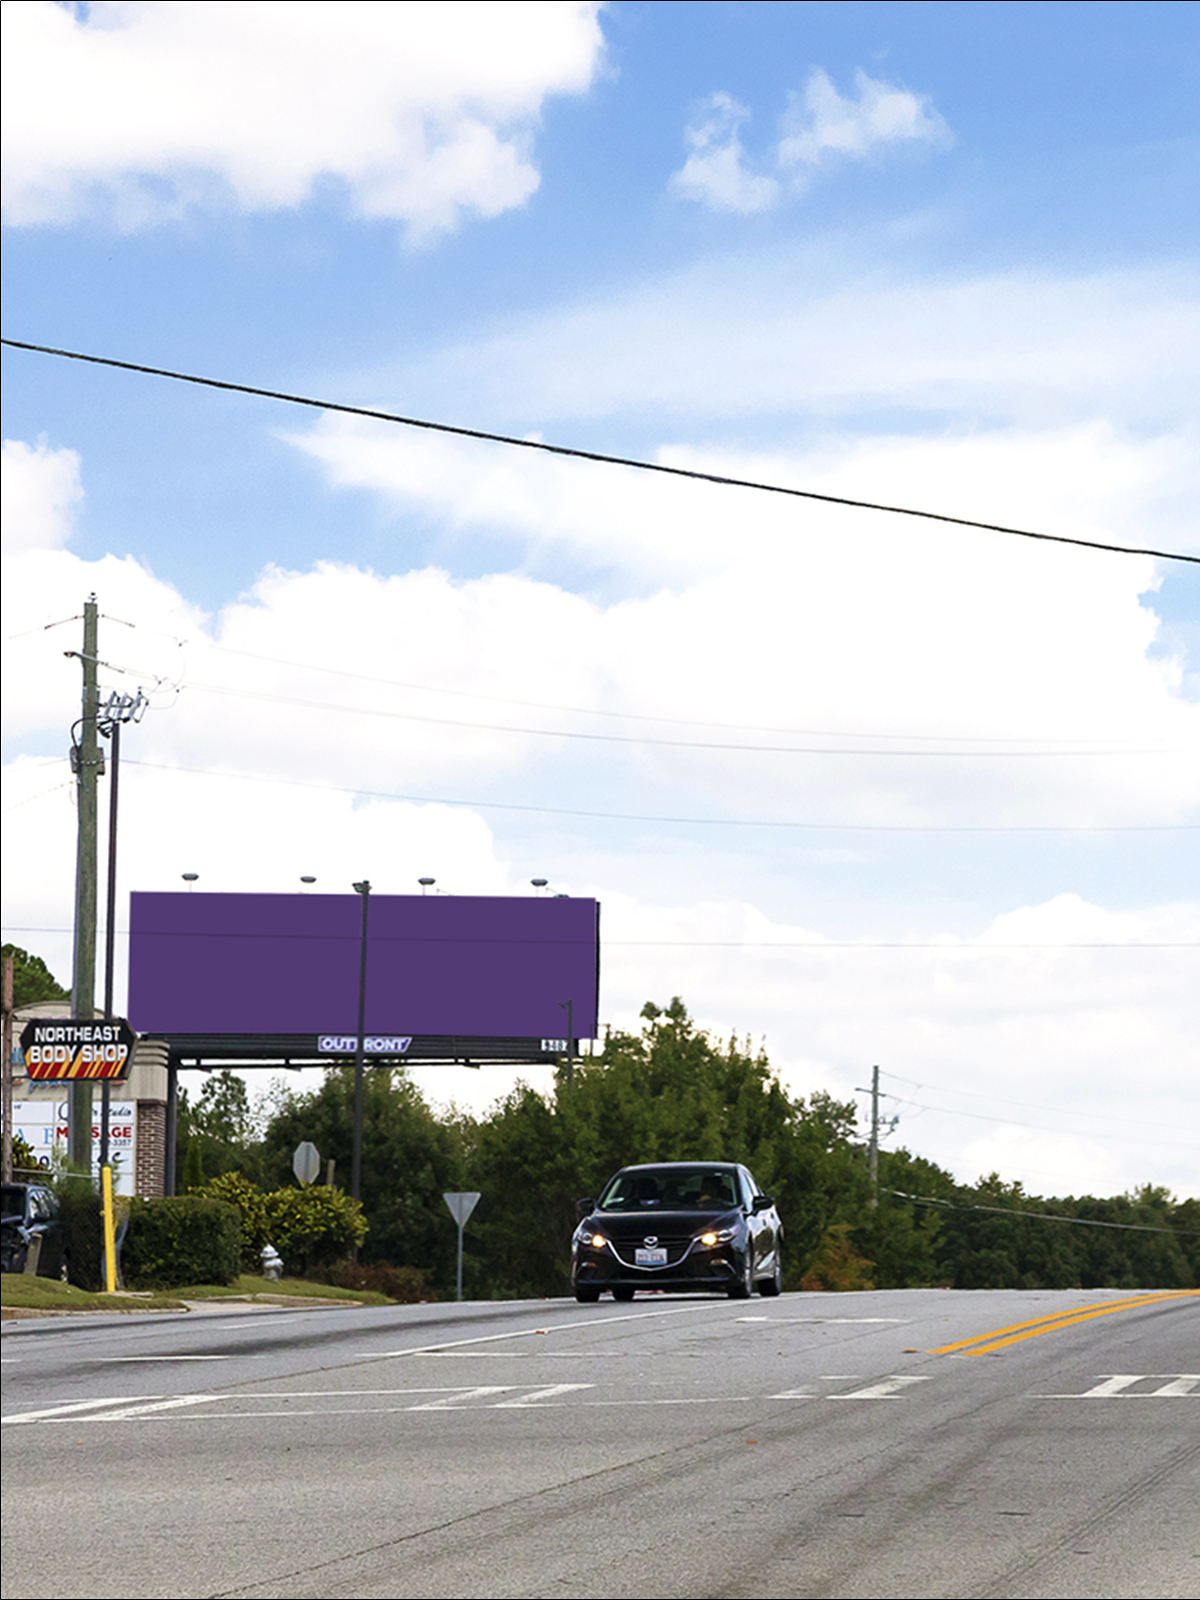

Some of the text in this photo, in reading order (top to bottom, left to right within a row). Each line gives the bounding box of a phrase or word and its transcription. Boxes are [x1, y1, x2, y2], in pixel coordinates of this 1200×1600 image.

[35, 1026, 121, 1042] NORTHEAST
[322, 1037, 405, 1050] OUTRONT
[30, 1045, 77, 1063] BODY
[81, 1044, 128, 1062] SHOP
[56, 1126, 132, 1139] MSGE
